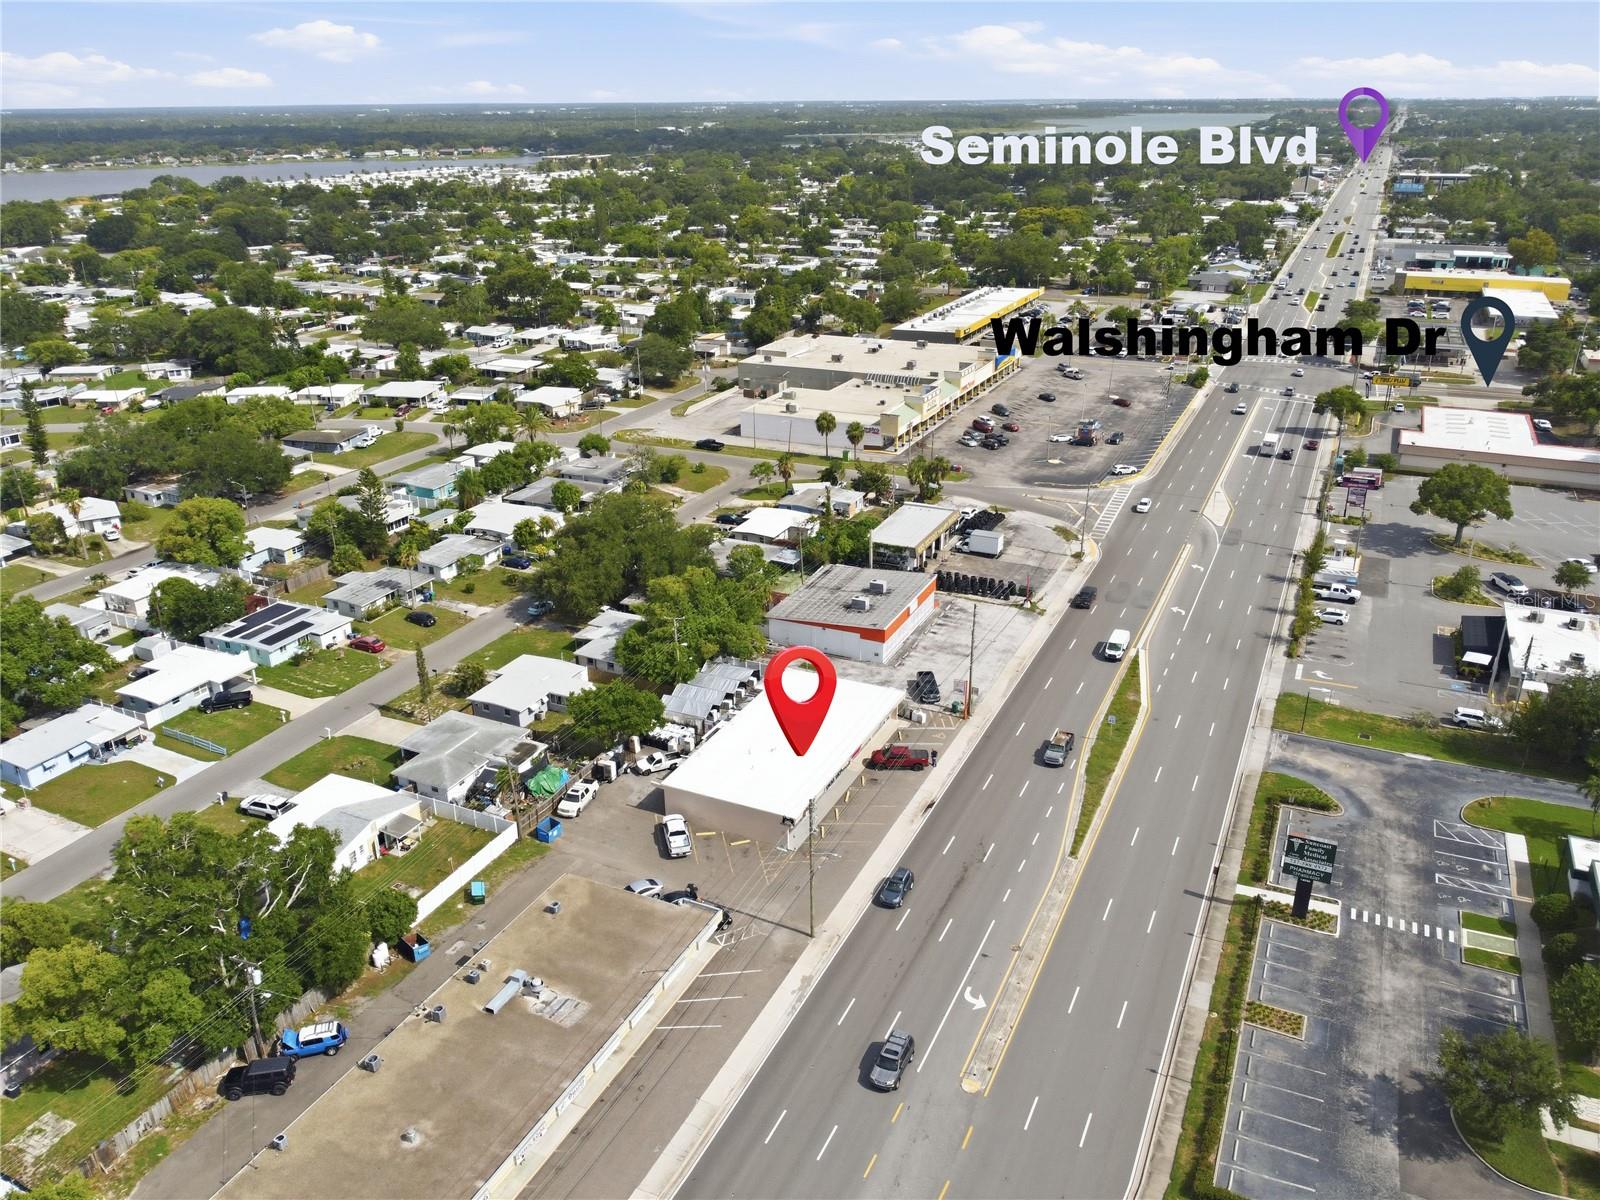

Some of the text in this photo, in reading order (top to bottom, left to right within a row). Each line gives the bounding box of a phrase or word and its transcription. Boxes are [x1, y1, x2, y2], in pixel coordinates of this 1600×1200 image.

[1304, 845, 1325, 855] Family
[1303, 851, 1328, 860] Medical
[1289, 865, 1324, 877] PHARMACY
